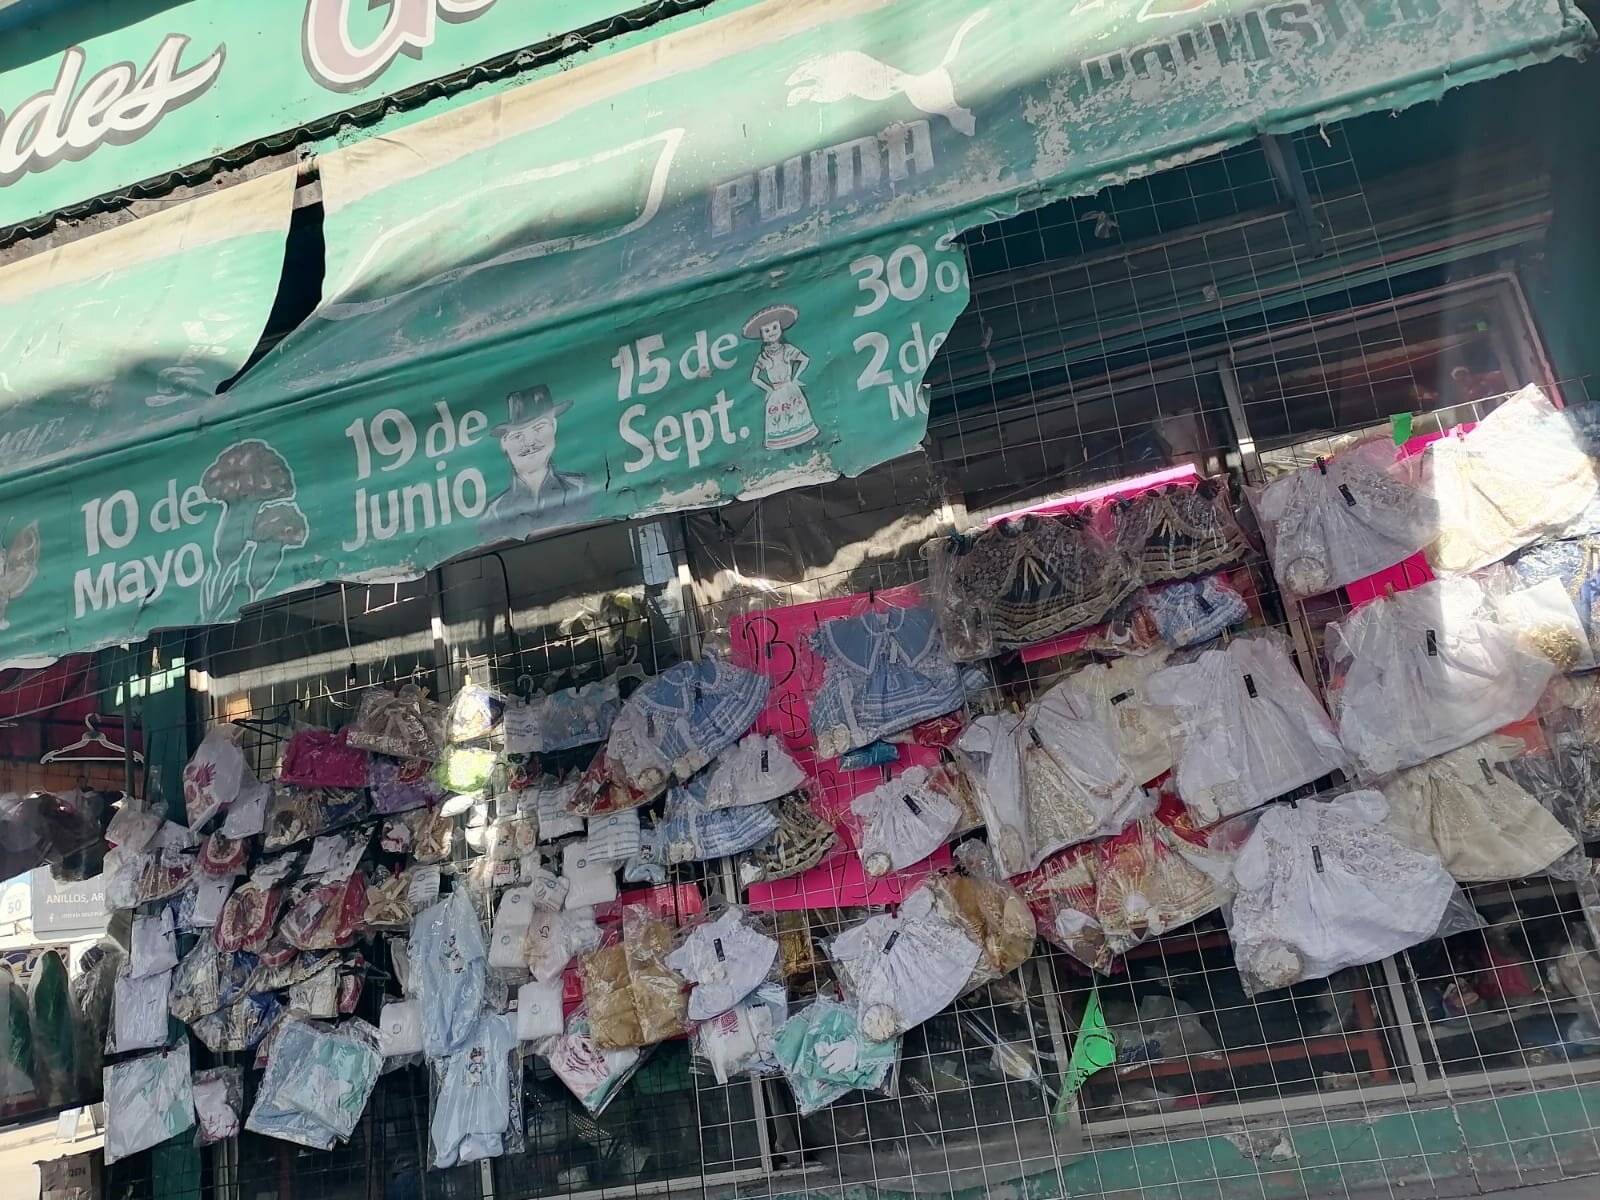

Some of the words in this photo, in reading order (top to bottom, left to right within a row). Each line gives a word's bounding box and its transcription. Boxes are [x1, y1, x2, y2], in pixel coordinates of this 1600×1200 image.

[711, 120, 935, 238] PUMA
[850, 244, 928, 317] 30
[611, 333, 671, 401] 15
[679, 331, 738, 379] de
[853, 331, 893, 391] 2
[899, 321, 948, 374] de
[345, 409, 416, 480] 19
[425, 400, 488, 458] de
[618, 389, 750, 474] Sept.
[81, 490, 138, 556] 10
[150, 478, 208, 533] de
[342, 460, 486, 552] Junio
[74, 542, 201, 618] Mayo
[8, 899, 21, 914] 50
[47, 893, 89, 905] ANILLOS,
